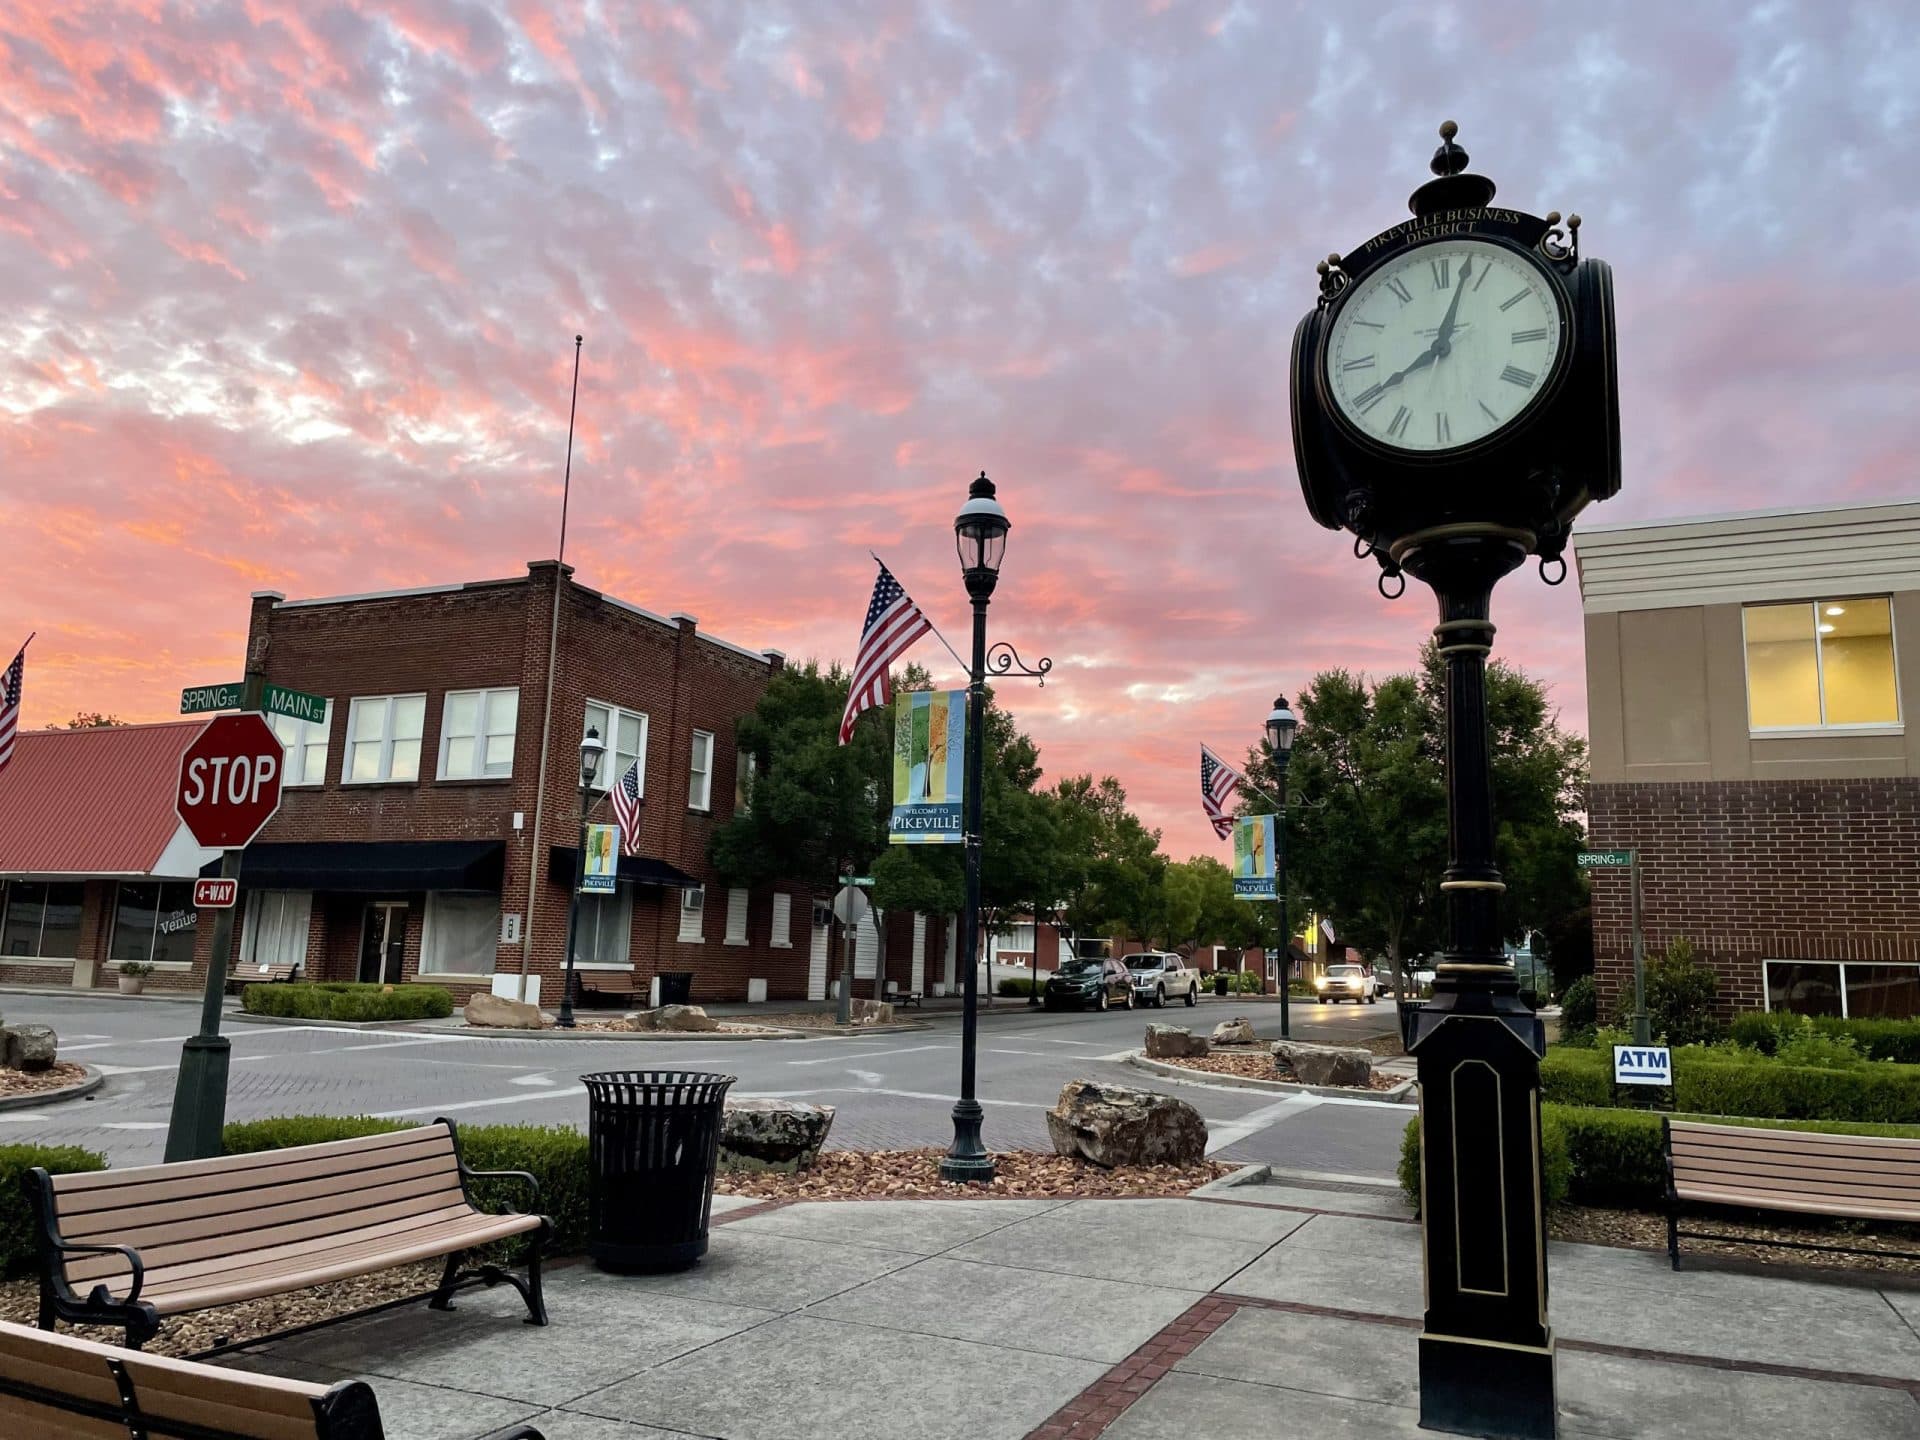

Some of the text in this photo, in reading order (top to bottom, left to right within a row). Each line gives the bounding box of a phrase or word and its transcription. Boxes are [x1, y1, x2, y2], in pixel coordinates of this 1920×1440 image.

[1365, 208, 1521, 252] PIKEVILLE BUSINESS
[1406, 221, 1477, 244] DISTRICT
[181, 688, 228, 711] SPRING
[270, 690, 324, 720] MAIN ST
[184, 755, 276, 806] STOP
[893, 815, 960, 830] PIKEVILLE
[1577, 854, 1616, 865] SPRING
[198, 885, 232, 901] 4-WAY
[160, 912, 198, 935] Venue
[1618, 1050, 1668, 1068] ATM
